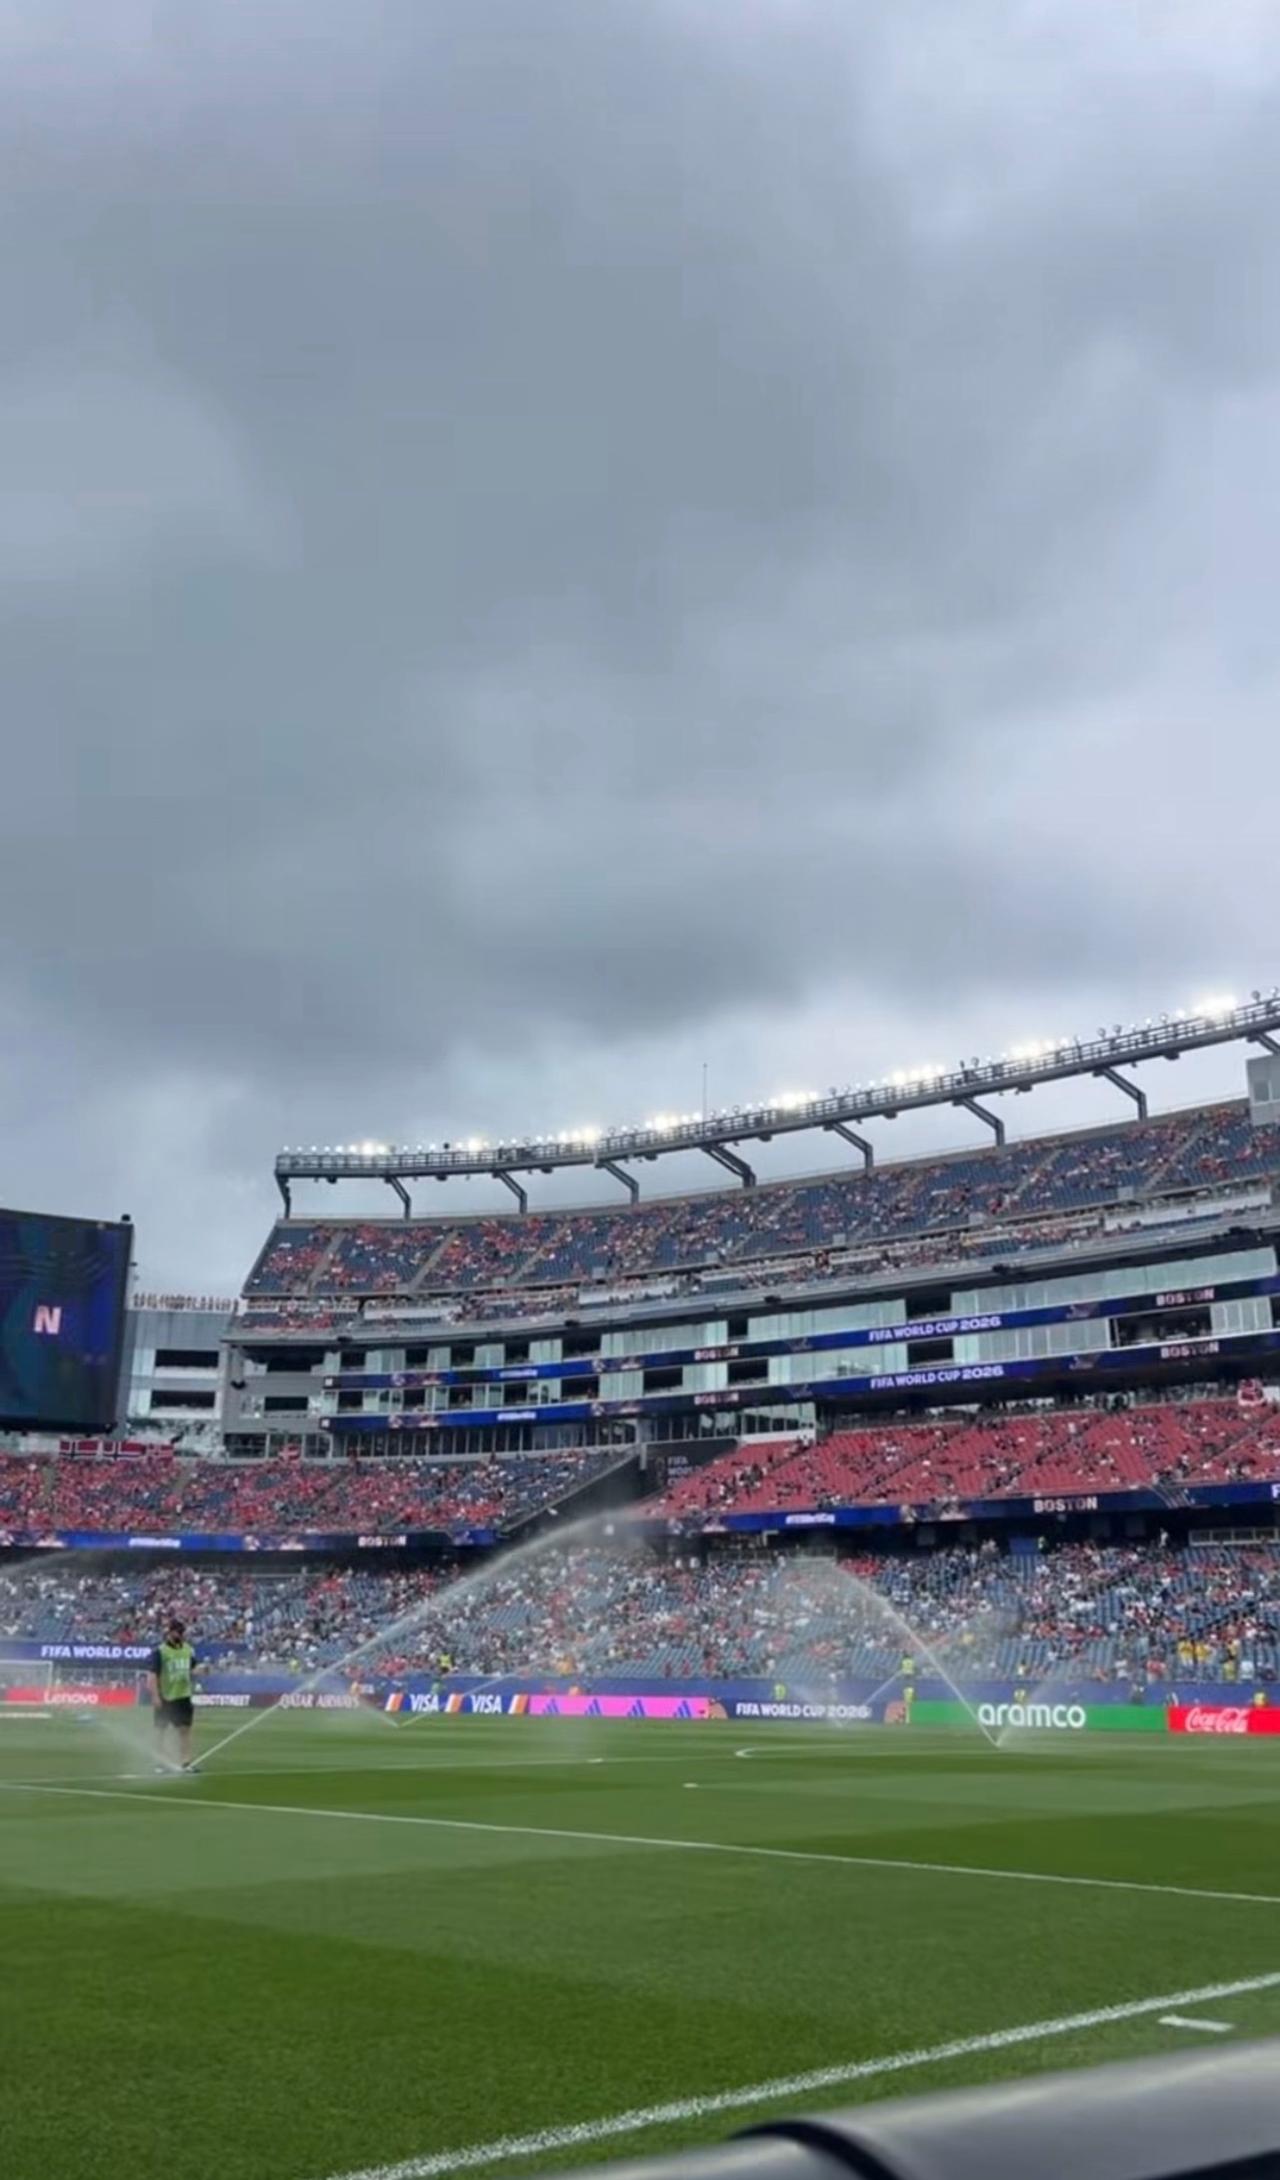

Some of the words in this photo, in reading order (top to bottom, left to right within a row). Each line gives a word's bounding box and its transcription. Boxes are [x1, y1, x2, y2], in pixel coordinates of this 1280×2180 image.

[869, 1329, 893, 1341] FIFA
[893, 1324, 933, 1337] WORLD
[935, 1321, 959, 1333] CUP
[960, 1316, 1002, 1330] 2026
[870, 1376, 895, 1389] FIFA
[895, 1372, 936, 1386] WORLD
[937, 1369, 961, 1382] CUP
[962, 1365, 1004, 1380] 2026
[1034, 1497, 1098, 1513] BOSTON
[41, 1645, 71, 1658] FIFA
[73, 1646, 121, 1658] WORLD
[124, 1646, 152, 1658] CUP
[43, 1690, 99, 1704] Lenovo
[410, 1694, 439, 1712] VISA
[470, 1694, 501, 1713] VISA
[736, 1702, 759, 1716] FIFA
[761, 1703, 800, 1717] WORLD
[802, 1704, 826, 1718] CUP
[978, 1703, 1087, 1728] aramco
